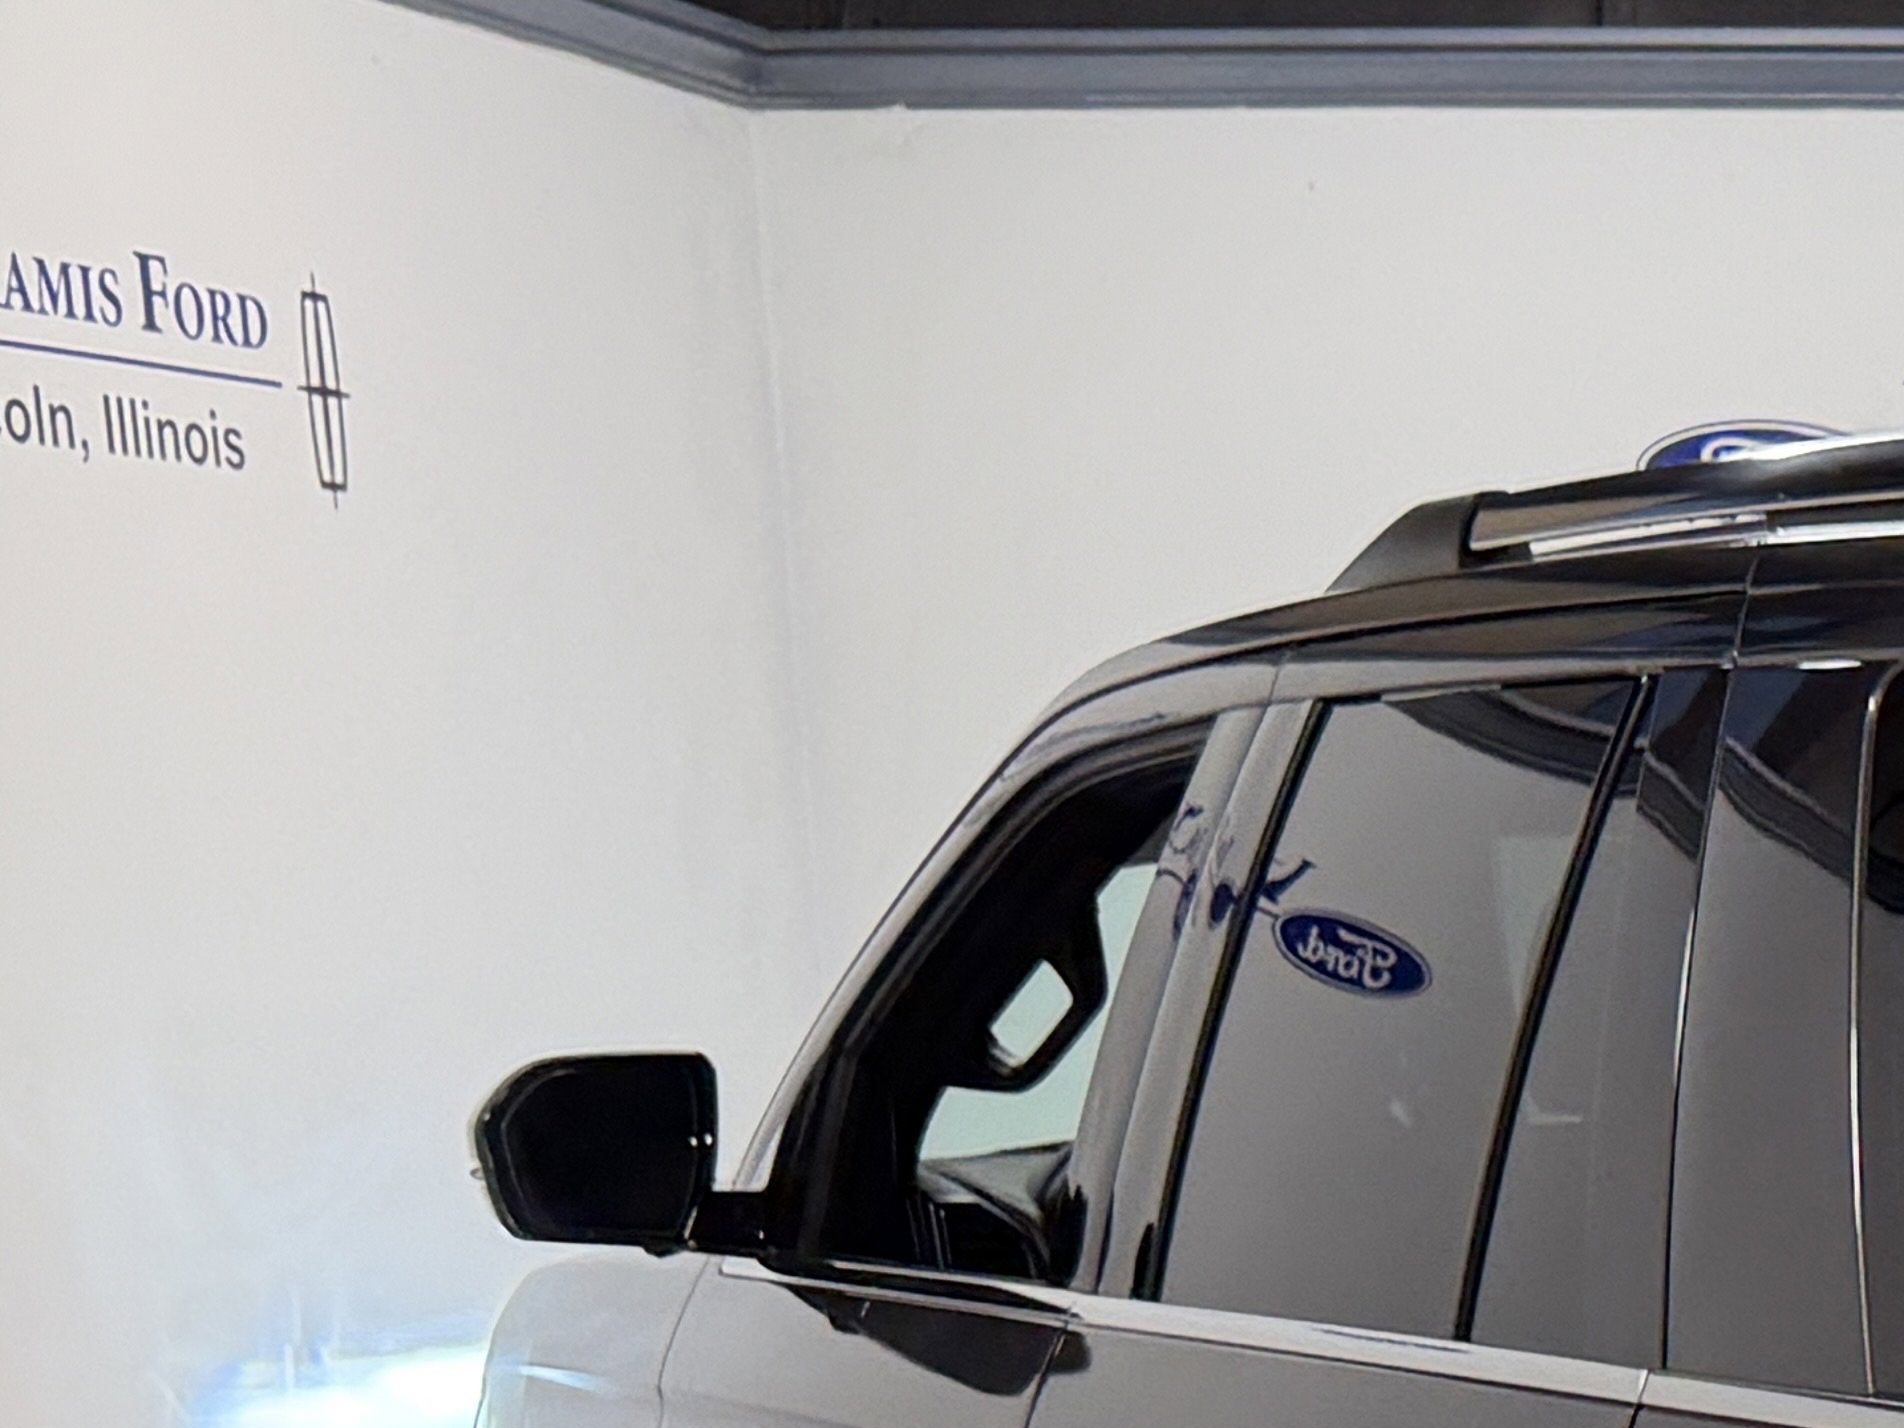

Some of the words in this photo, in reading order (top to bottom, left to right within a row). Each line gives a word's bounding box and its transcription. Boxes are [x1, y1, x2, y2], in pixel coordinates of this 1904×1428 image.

[132, 250, 268, 349] FORD
[0, 384, 90, 464] oln,
[103, 393, 246, 471] Illinois
